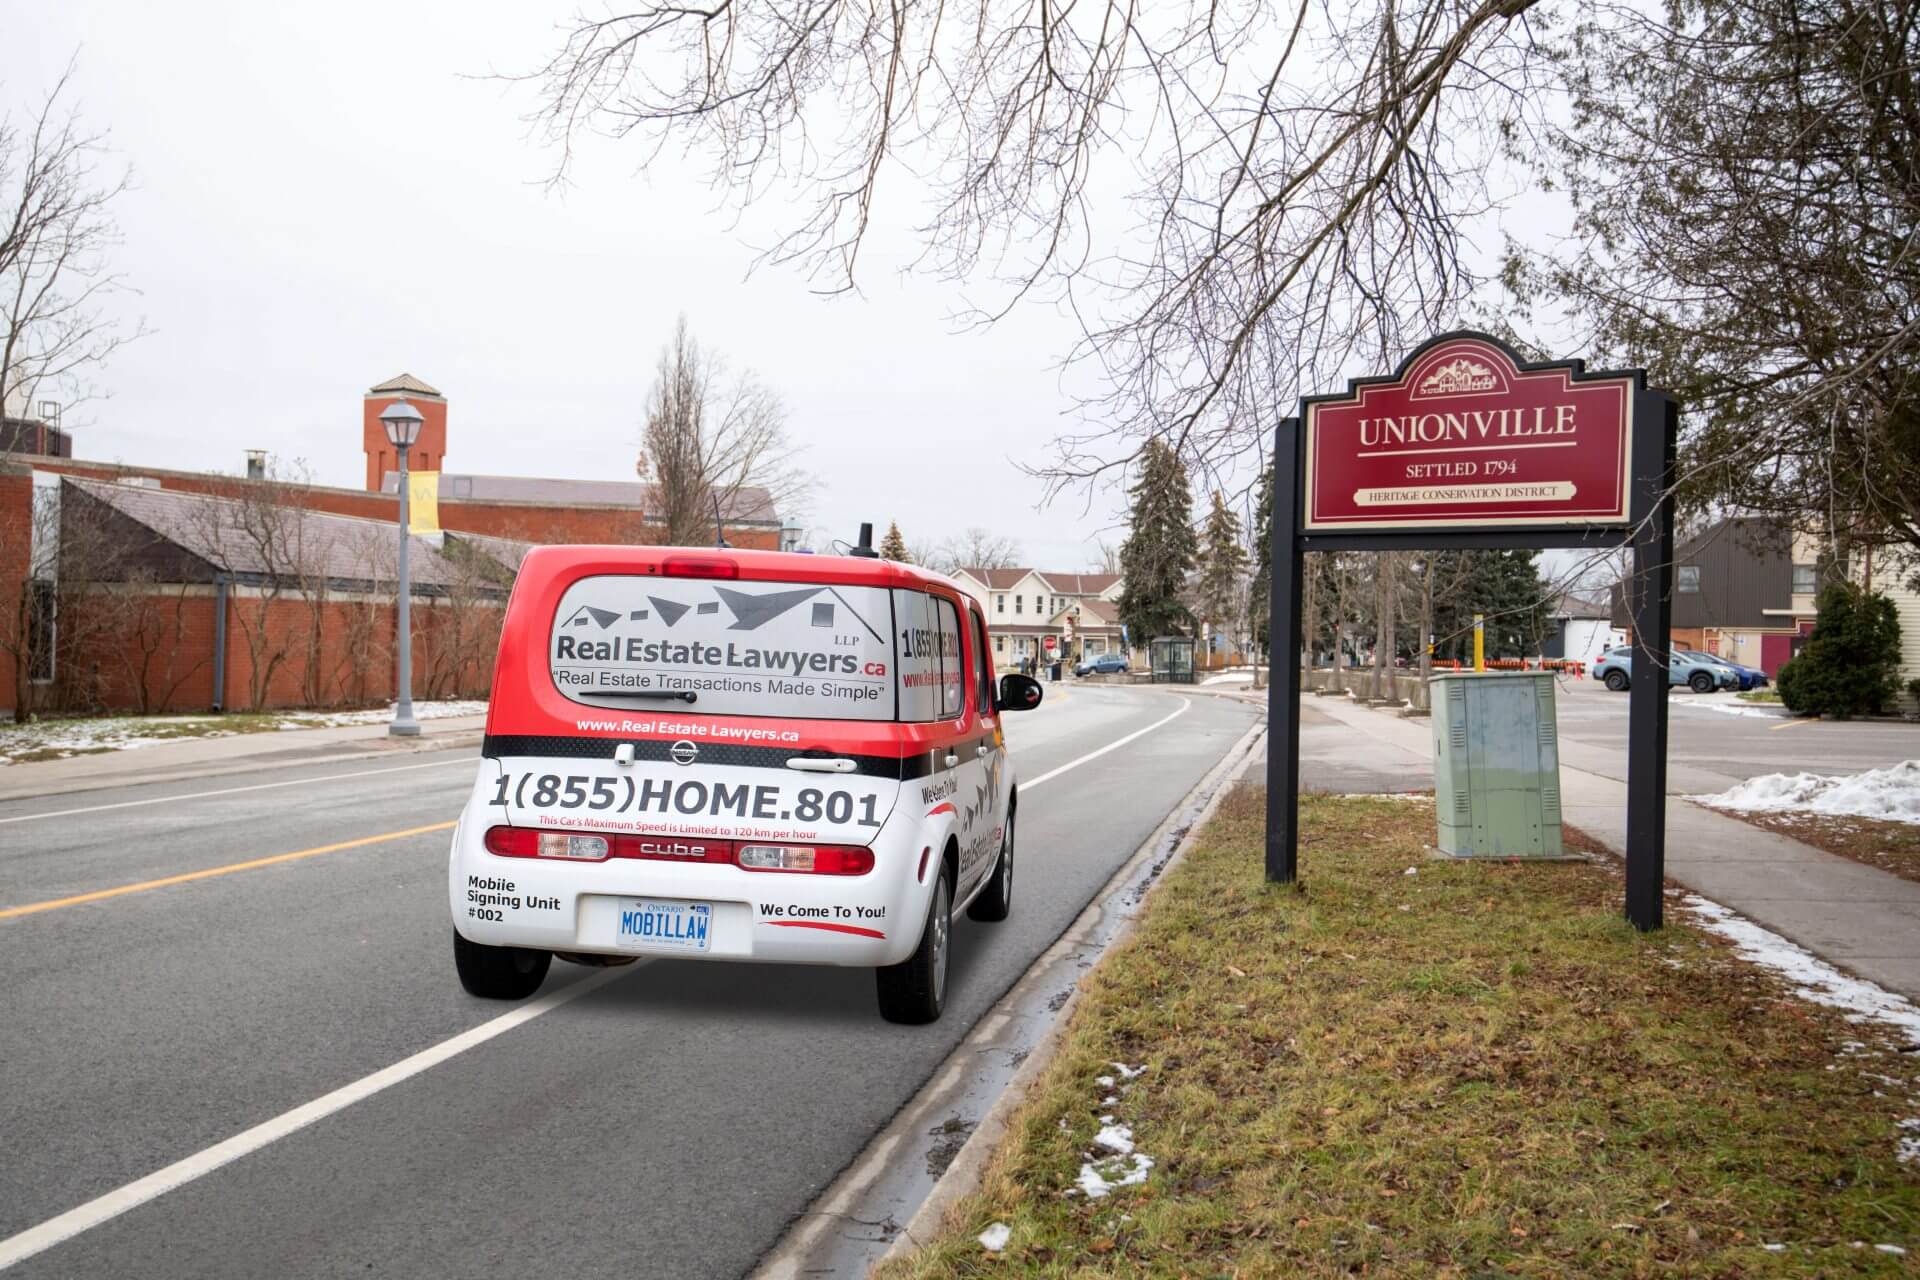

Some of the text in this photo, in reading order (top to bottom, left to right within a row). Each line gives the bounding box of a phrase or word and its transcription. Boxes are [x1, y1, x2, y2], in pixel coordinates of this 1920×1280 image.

[1358, 405, 1577, 446] UNIONVILLE
[1406, 459, 1518, 478] SETTLED 1794
[1369, 486, 1558, 502] HERITAGE CONSERVATION DISTRICT
[834, 635, 859, 646] LLP
[600, 671, 650, 687] Estate
[656, 674, 762, 694] Transactions
[768, 680, 815, 696] Made
[489, 772, 881, 828] 1(855)HOME.801
[538, 815, 558, 826] This
[584, 818, 634, 831] Maximum
[635, 823, 667, 834] Speed
[669, 824, 678, 833] is
[679, 824, 717, 835] Limited
[720, 826, 730, 835] to
[735, 827, 751, 837] 120
[754, 828, 770, 838] km
[773, 831, 790, 840] per
[793, 828, 817, 839] hour
[640, 842, 706, 857] cube
[467, 889, 561, 911] Signing Unit
[647, 903, 685, 913] ONTARIO
[468, 906, 503, 922] #002
[760, 903, 886, 919] We Come To You!
[621, 911, 708, 940] MOBILLAW
